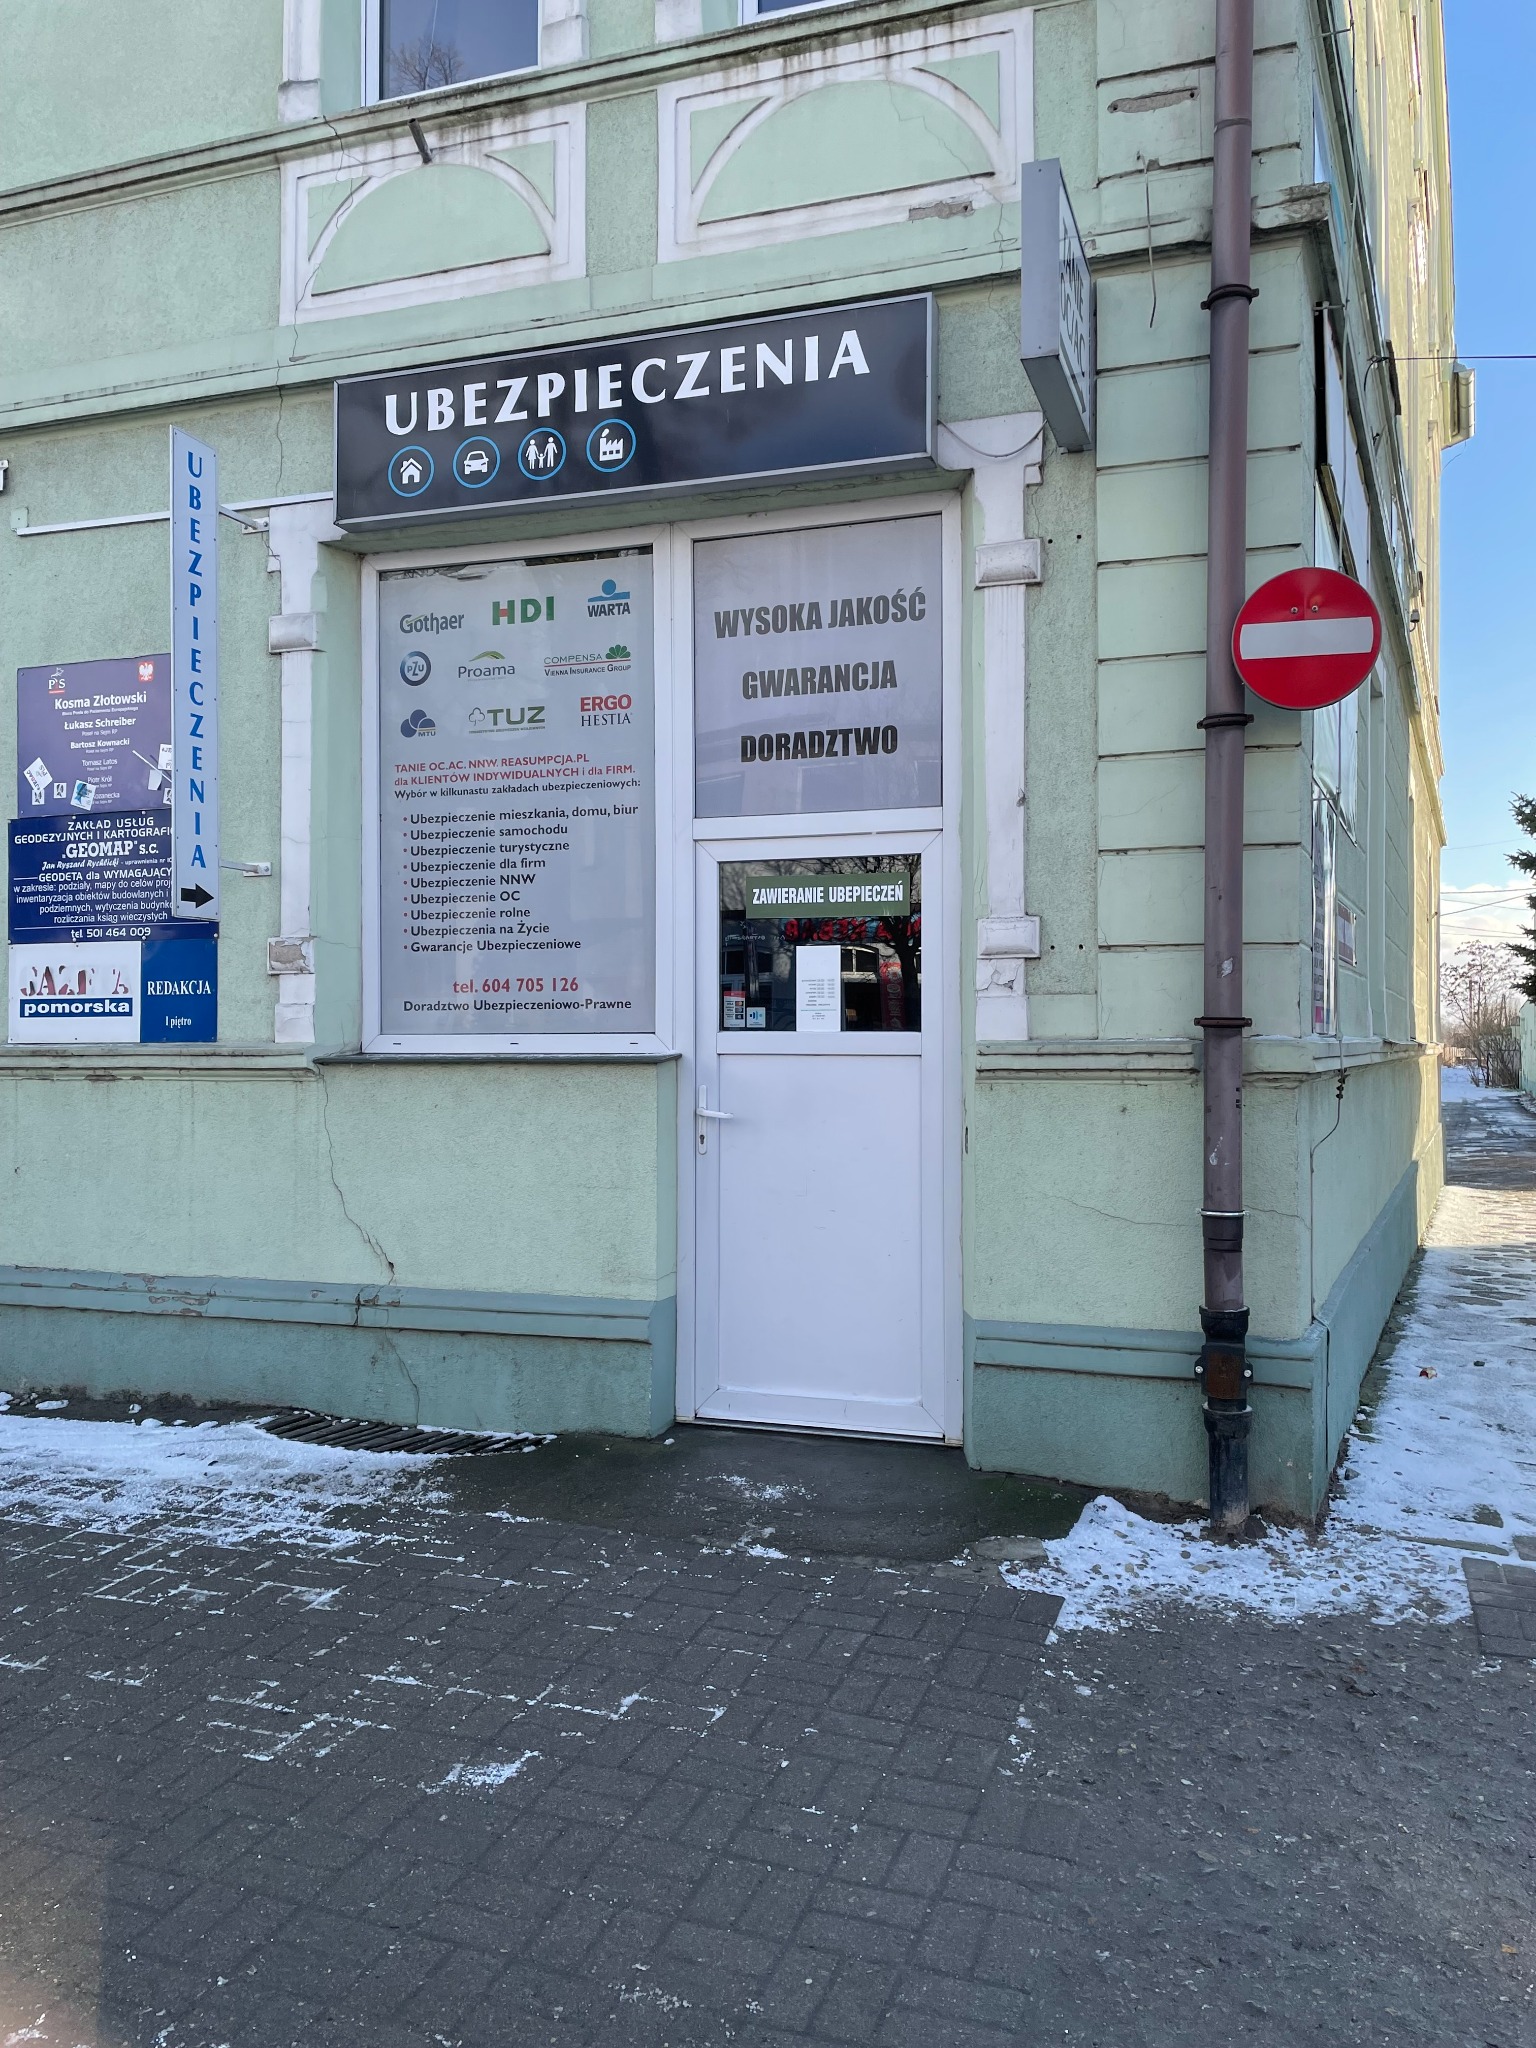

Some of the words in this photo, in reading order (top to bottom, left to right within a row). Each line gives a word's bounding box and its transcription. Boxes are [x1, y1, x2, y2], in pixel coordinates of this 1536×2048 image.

[1062, 217, 1084, 323] TANIE
[384, 329, 870, 437] UBEZPIECZENIA
[492, 596, 555, 626] HDI
[587, 602, 631, 618] WARTA
[714, 601, 823, 639] WYSOKA
[828, 586, 926, 629] JAKOŚĆ
[400, 612, 465, 635] Gothaer
[187, 451, 207, 869] UBEZPIECZENIA
[544, 653, 603, 665] COMPENSA
[458, 664, 515, 679] Proama
[742, 660, 898, 700] GWARANCJA
[55, 698, 91, 710] Kosma
[93, 690, 147, 707] Złotowski
[580, 693, 632, 713] ERGO
[64, 720, 94, 730] Łukasz
[95, 716, 137, 728] Schreiber
[486, 706, 546, 727] TUZ
[581, 712, 631, 727] HESTIA
[70, 741, 96, 750] Bartosz
[97, 737, 130, 748] Kownacki
[740, 725, 898, 763] DORADZTWO
[82, 759, 102, 767] Tomasz
[395, 762, 427, 774] TANIE
[501, 753, 589, 768] REASUMPCJA.PL
[394, 776, 409, 786] dla
[410, 771, 471, 785] KLIENTÓW
[473, 767, 580, 782] INDYWIDUALNYCH
[588, 765, 604, 776] dla
[605, 764, 636, 775] FIRM.
[94, 791, 121, 800] ozanecka
[395, 788, 428, 801] Wybór
[429, 789, 438, 798] w
[440, 785, 489, 797] kilkunastu
[491, 782, 539, 794] zakładach
[542, 777, 641, 793] ubezpieczeniowych:
[410, 811, 496, 826] Ubezpieczenie
[499, 806, 570, 821] mieszkania,
[571, 806, 611, 819] domu,
[613, 803, 639, 816] biur
[67, 819, 111, 831] ZAKŁAD
[117, 816, 154, 828] USŁUG
[14, 831, 93, 844] GEODEZYJNYCH
[410, 827, 496, 842] Ubezpieczenie
[499, 823, 569, 837] samochodu
[410, 843, 496, 858] Ubezpieczenie
[499, 840, 570, 855] turystyczne
[42, 861, 56, 872] Jan
[57, 859, 86, 871] Ryszard
[410, 859, 496, 874] Ubezpieczenie
[499, 858, 517, 869] dla
[520, 858, 546, 869] firm
[39, 871, 83, 882] GEODETA
[86, 870, 100, 880] dla
[411, 875, 496, 890] Ubezpieczenie
[499, 873, 537, 886] NNW
[21, 882, 57, 893] zakresie:
[58, 881, 93, 893] podziały,
[95, 881, 116, 891] mapy
[118, 880, 129, 889] do
[130, 878, 153, 889] celów
[156, 877, 173, 889] proj
[752, 886, 825, 904] ZAWIERANIE
[828, 880, 904, 904] UBEPIECZEŃ
[16, 892, 73, 905] inwentaryzacja
[75, 890, 111, 902] obiektów
[112, 888, 164, 900] budowlanych
[411, 892, 496, 907] Ubezpieczenie
[499, 890, 521, 902] OC
[94, 901, 139, 913] wytyczenia
[411, 908, 496, 923] Ubezpieczenie
[499, 906, 531, 919] rolne
[119, 910, 168, 923] wieczystych
[86, 928, 103, 938] 501
[105, 927, 127, 937] 464
[130, 927, 151, 937] 009
[411, 924, 496, 939] Ubezpieczenia
[499, 926, 514, 935] na
[516, 920, 550, 937] Życie
[411, 941, 473, 955] Gwarancje
[476, 939, 582, 954] Ubezpieczeniowe
[147, 979, 212, 996] REDAKCJA
[453, 979, 478, 994] tel.
[482, 978, 511, 993] 604
[516, 977, 544, 992] 705
[551, 976, 579, 992] 126
[24, 999, 130, 1016] pomorska
[403, 1000, 470, 1012] Doradztwo
[473, 998, 632, 1014] Ubezpieczeniowo-Prawne
[170, 1015, 192, 1029] piętro
